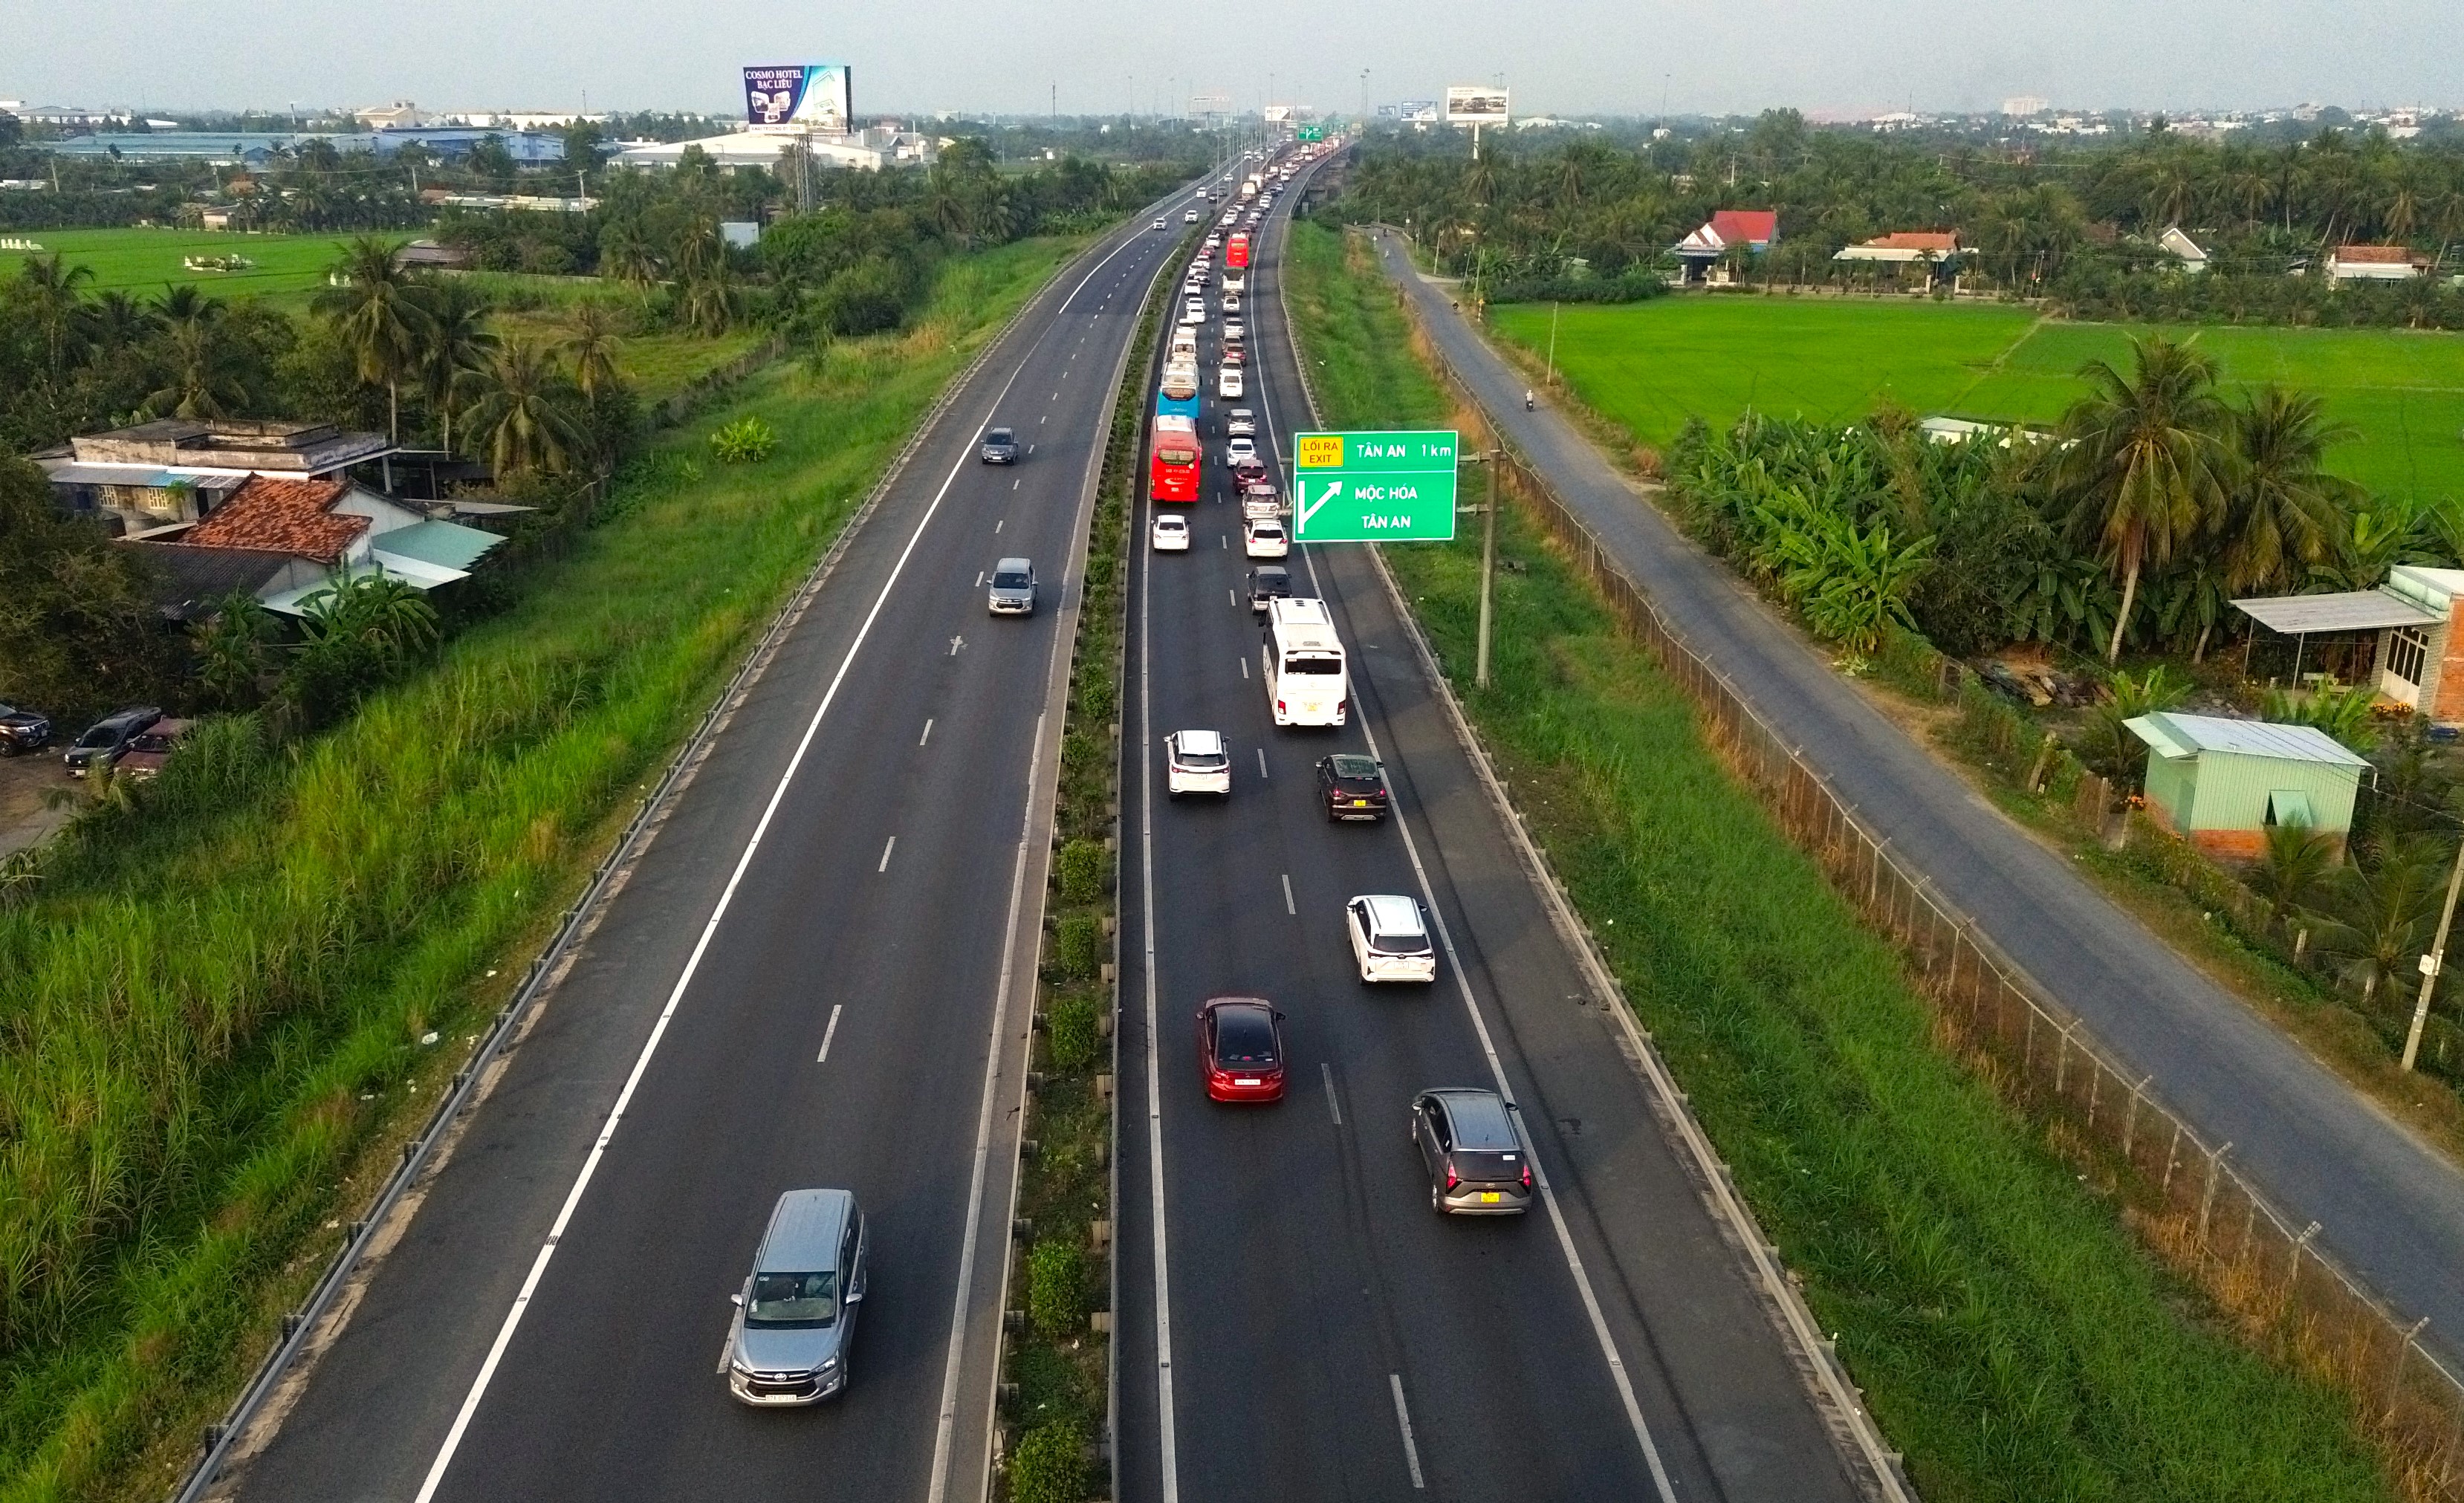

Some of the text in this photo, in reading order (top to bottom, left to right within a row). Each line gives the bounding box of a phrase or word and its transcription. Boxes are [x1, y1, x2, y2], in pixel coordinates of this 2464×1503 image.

[745, 69, 803, 79] COSMO HOTEL
[756, 78, 792, 90] BẠC LIÊU
[1303, 440, 1338, 451] LỐI RA
[1357, 441, 1451, 458] TÂN AN 1 km
[1309, 455, 1332, 463] EXIT
[1355, 482, 1418, 502] MỘC HÓA
[1361, 513, 1411, 528] TÂN AN
